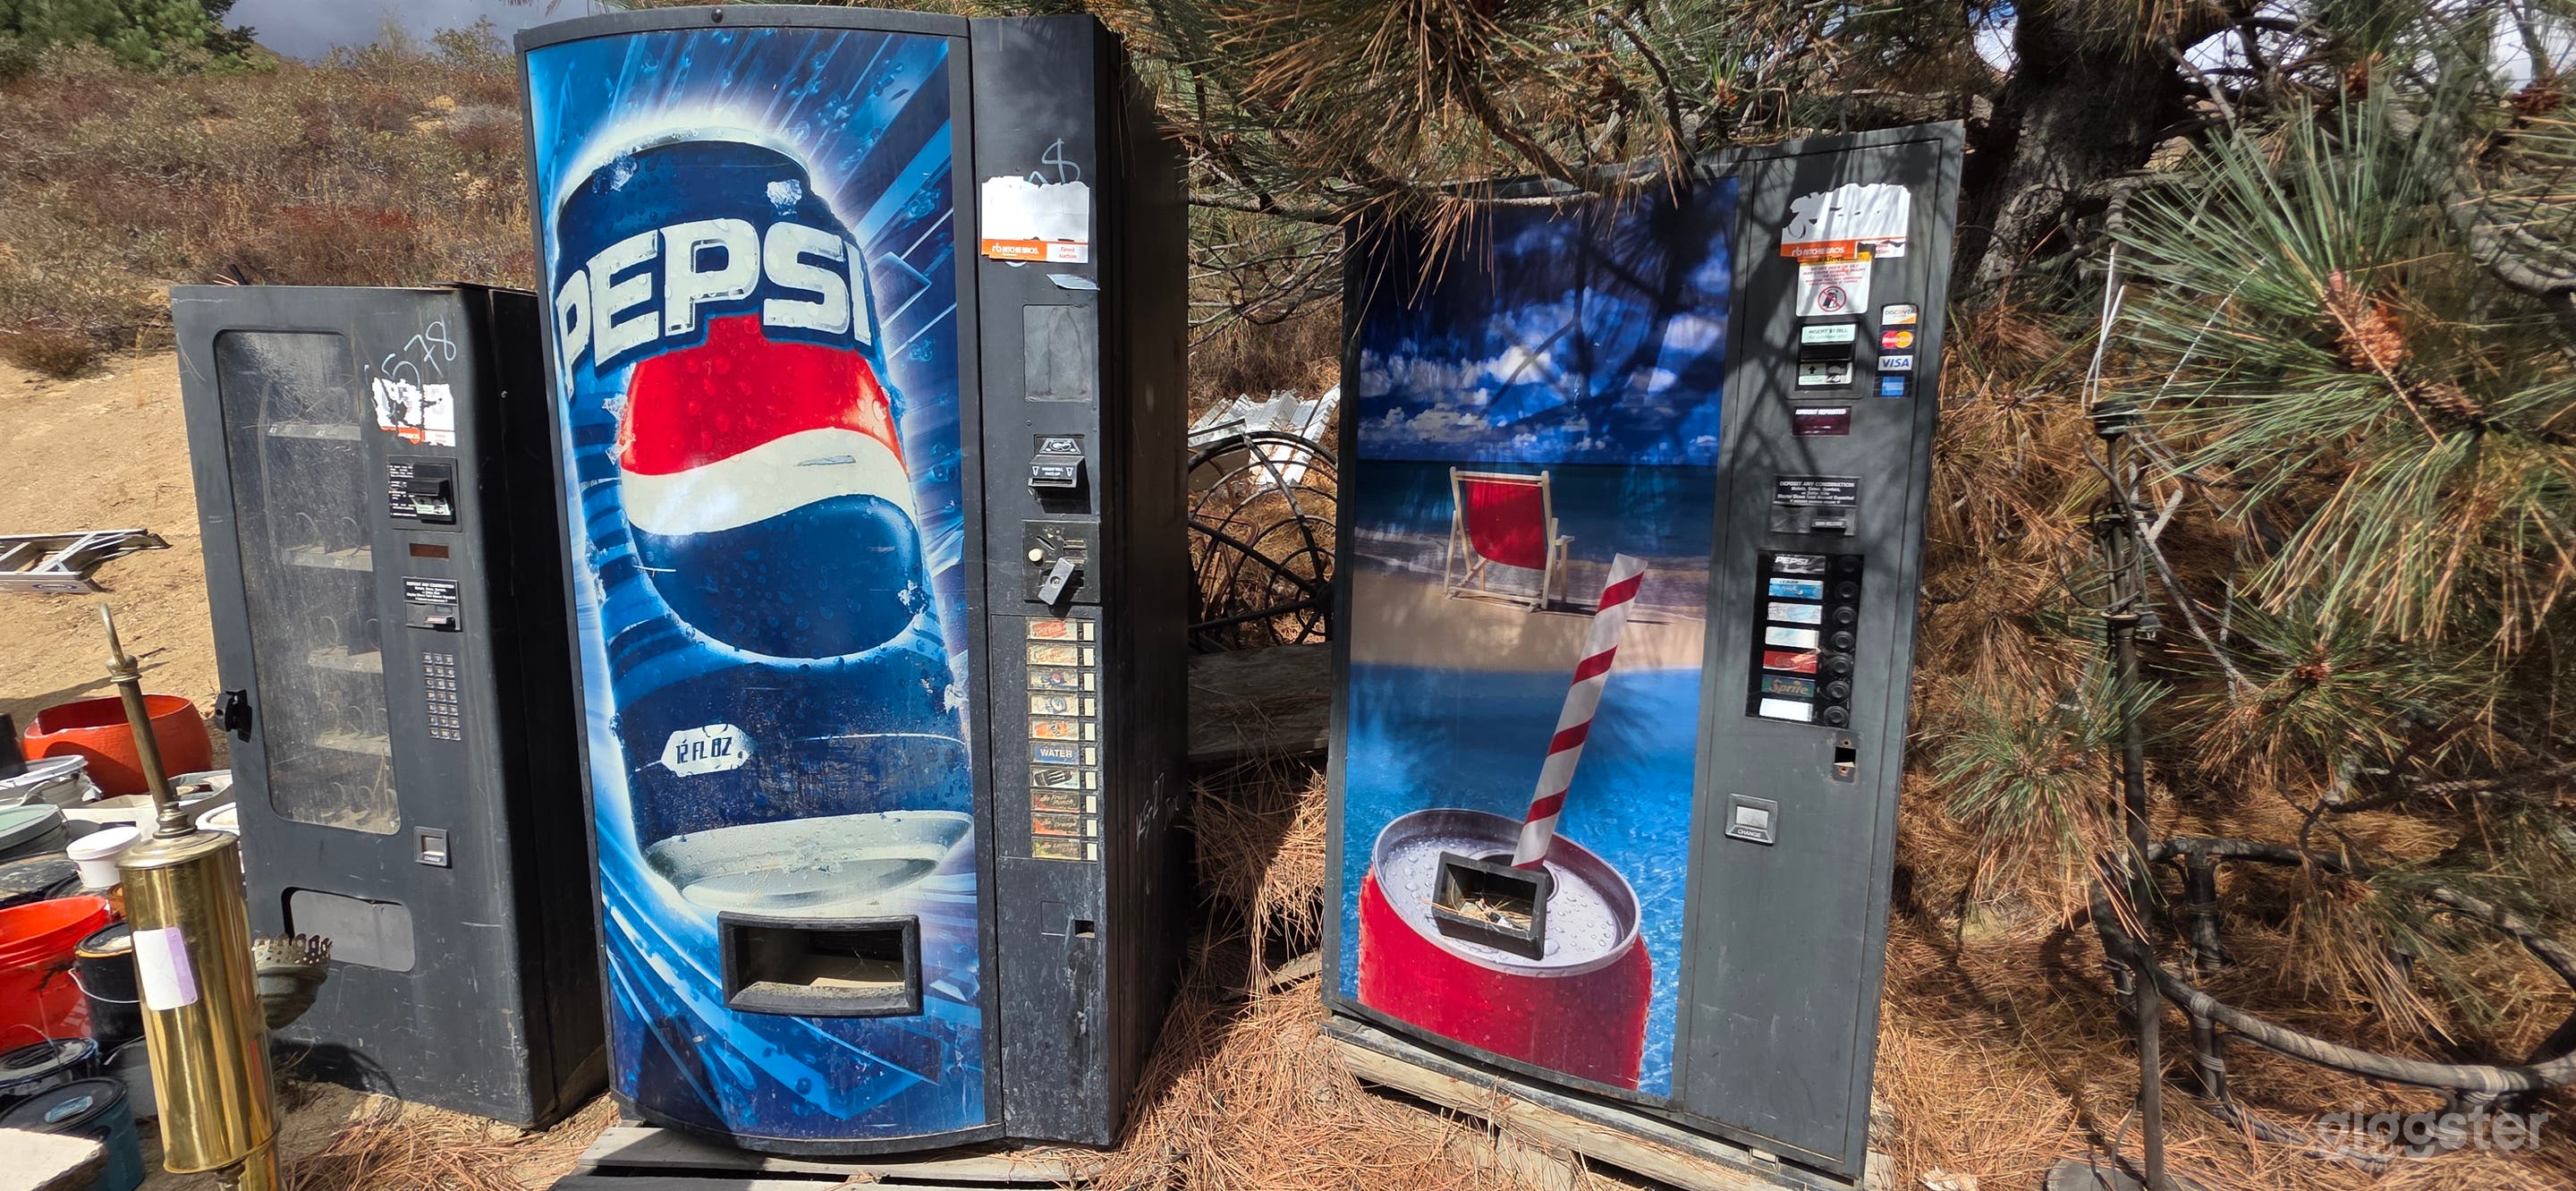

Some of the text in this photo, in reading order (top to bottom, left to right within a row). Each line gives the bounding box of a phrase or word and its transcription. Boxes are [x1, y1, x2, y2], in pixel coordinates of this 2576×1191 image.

[555, 217, 872, 401] PEPSI
[1882, 358, 1910, 368] VISA
[1768, 678, 1809, 694] Sprite
[1039, 748, 1072, 758] WATER
